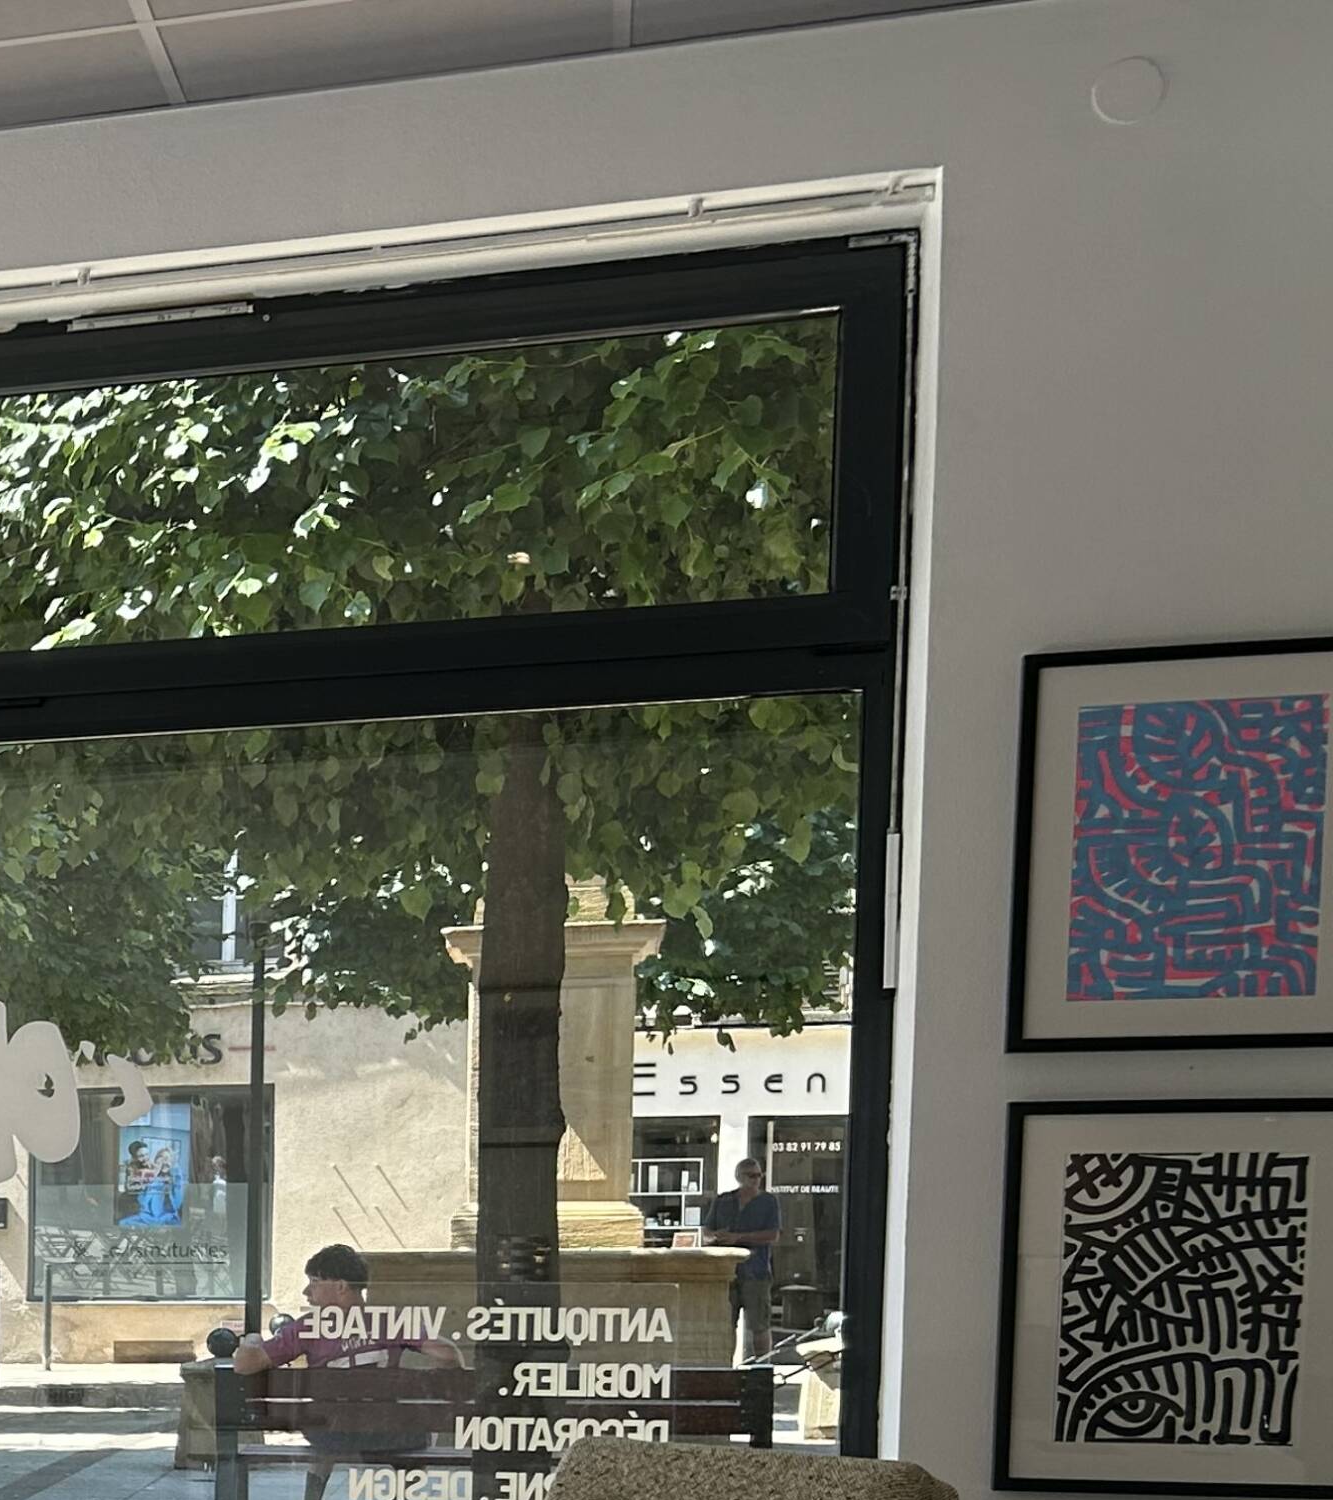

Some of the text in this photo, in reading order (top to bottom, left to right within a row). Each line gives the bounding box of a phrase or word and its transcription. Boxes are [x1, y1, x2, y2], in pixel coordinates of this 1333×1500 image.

[773, 1141, 841, 1152] 03 82 91 79 85
[800, 1185, 810, 1193] DE
